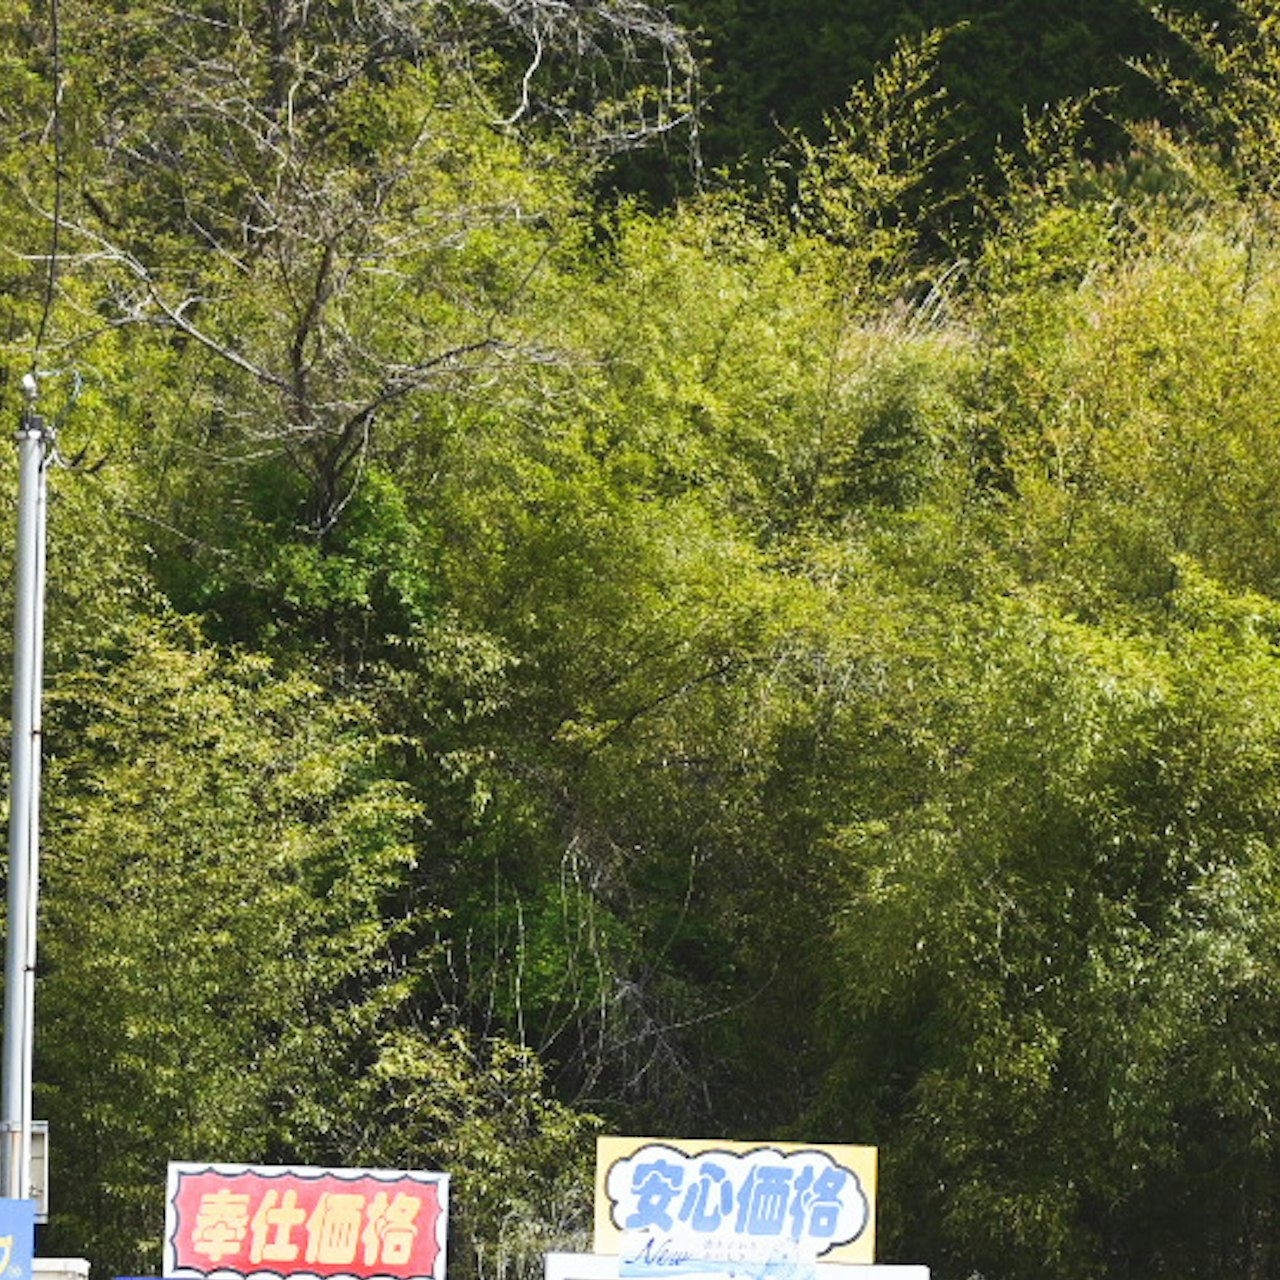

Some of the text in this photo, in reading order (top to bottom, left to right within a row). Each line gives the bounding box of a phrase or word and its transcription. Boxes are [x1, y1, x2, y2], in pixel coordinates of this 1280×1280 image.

[192, 1188, 422, 1266] 奉仕価格
[625, 1158, 848, 1238] 安心価格
